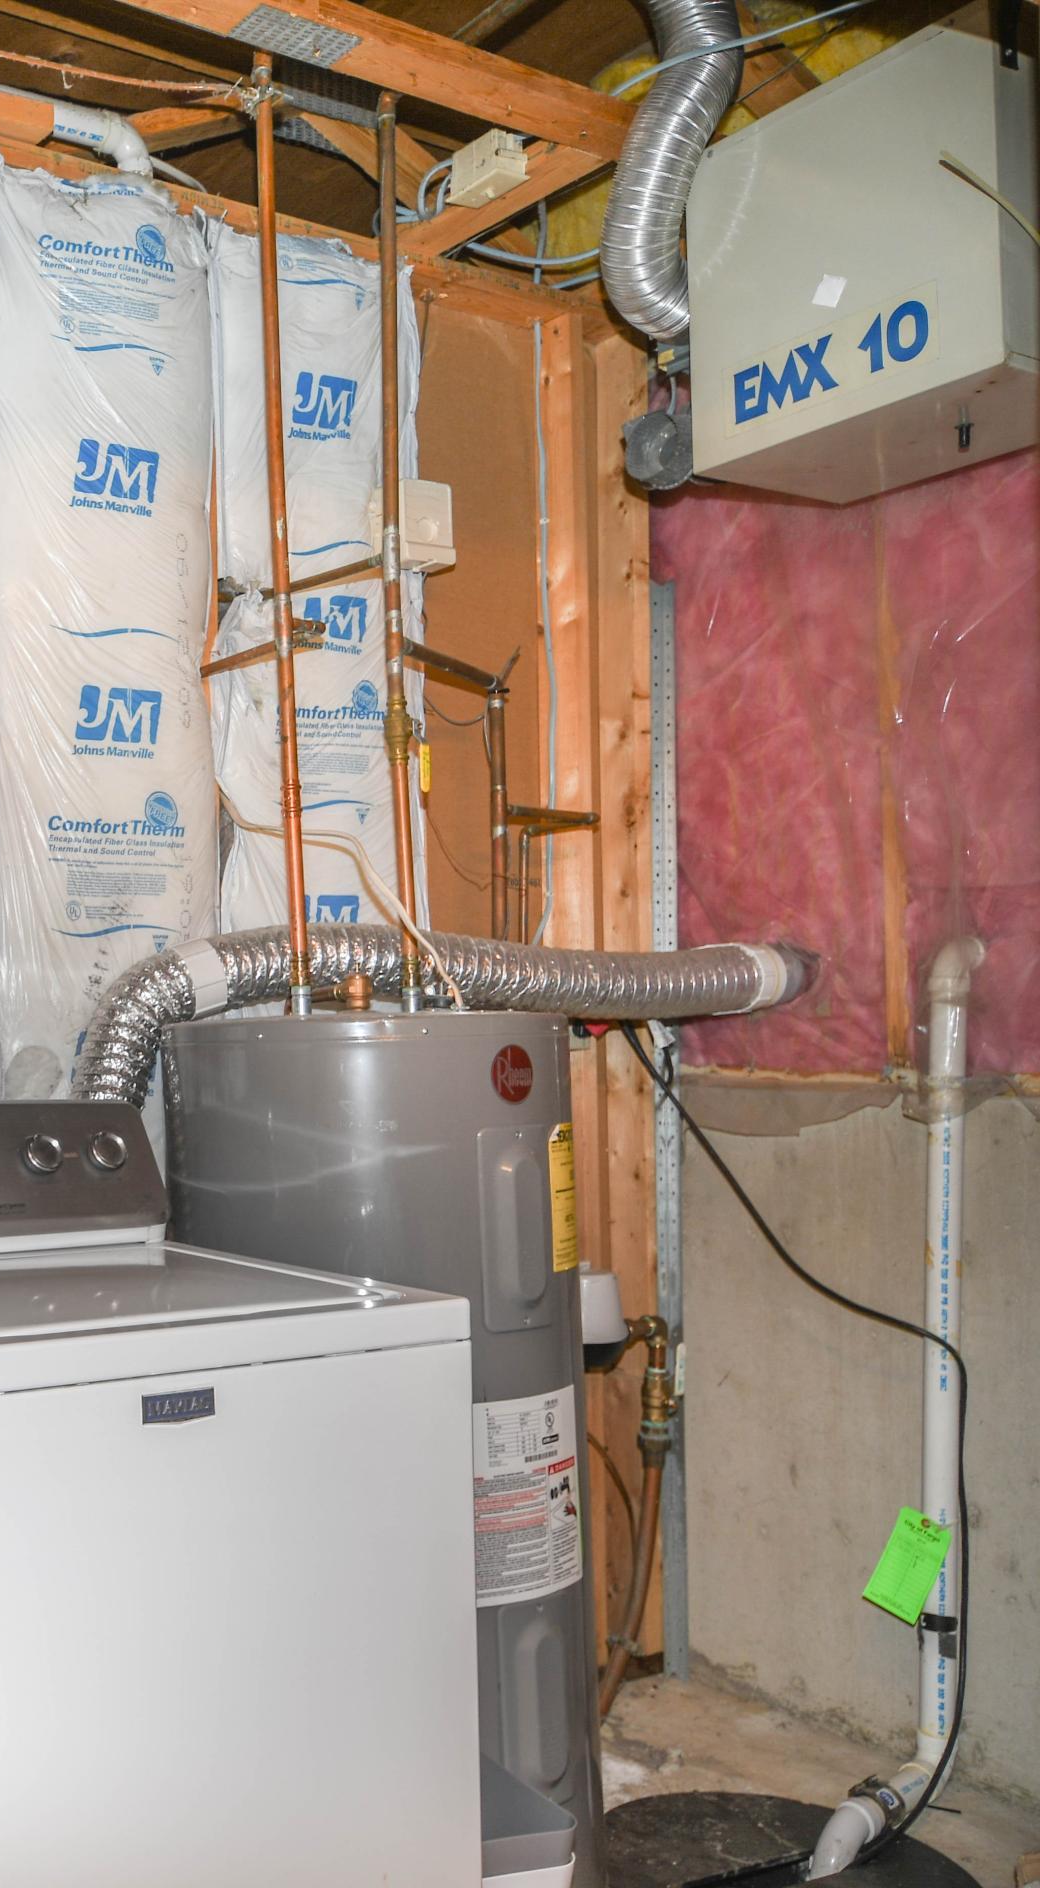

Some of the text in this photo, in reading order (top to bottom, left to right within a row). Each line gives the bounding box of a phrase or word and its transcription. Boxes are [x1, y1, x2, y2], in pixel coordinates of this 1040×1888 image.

[38, 234, 174, 273] ComfortTherm
[96, 259, 115, 269] Fiber
[734, 300, 929, 425] EMX 10
[292, 371, 358, 430] JM
[288, 427, 311, 440] Johns
[74, 438, 160, 504] JM
[70, 495, 153, 518] Johns Manville
[75, 685, 163, 745] JM
[72, 744, 155, 760] Johns Manville
[48, 815, 185, 838] ComfortTherm
[100, 847, 125, 856] Sound
[127, 849, 156, 857] Control
